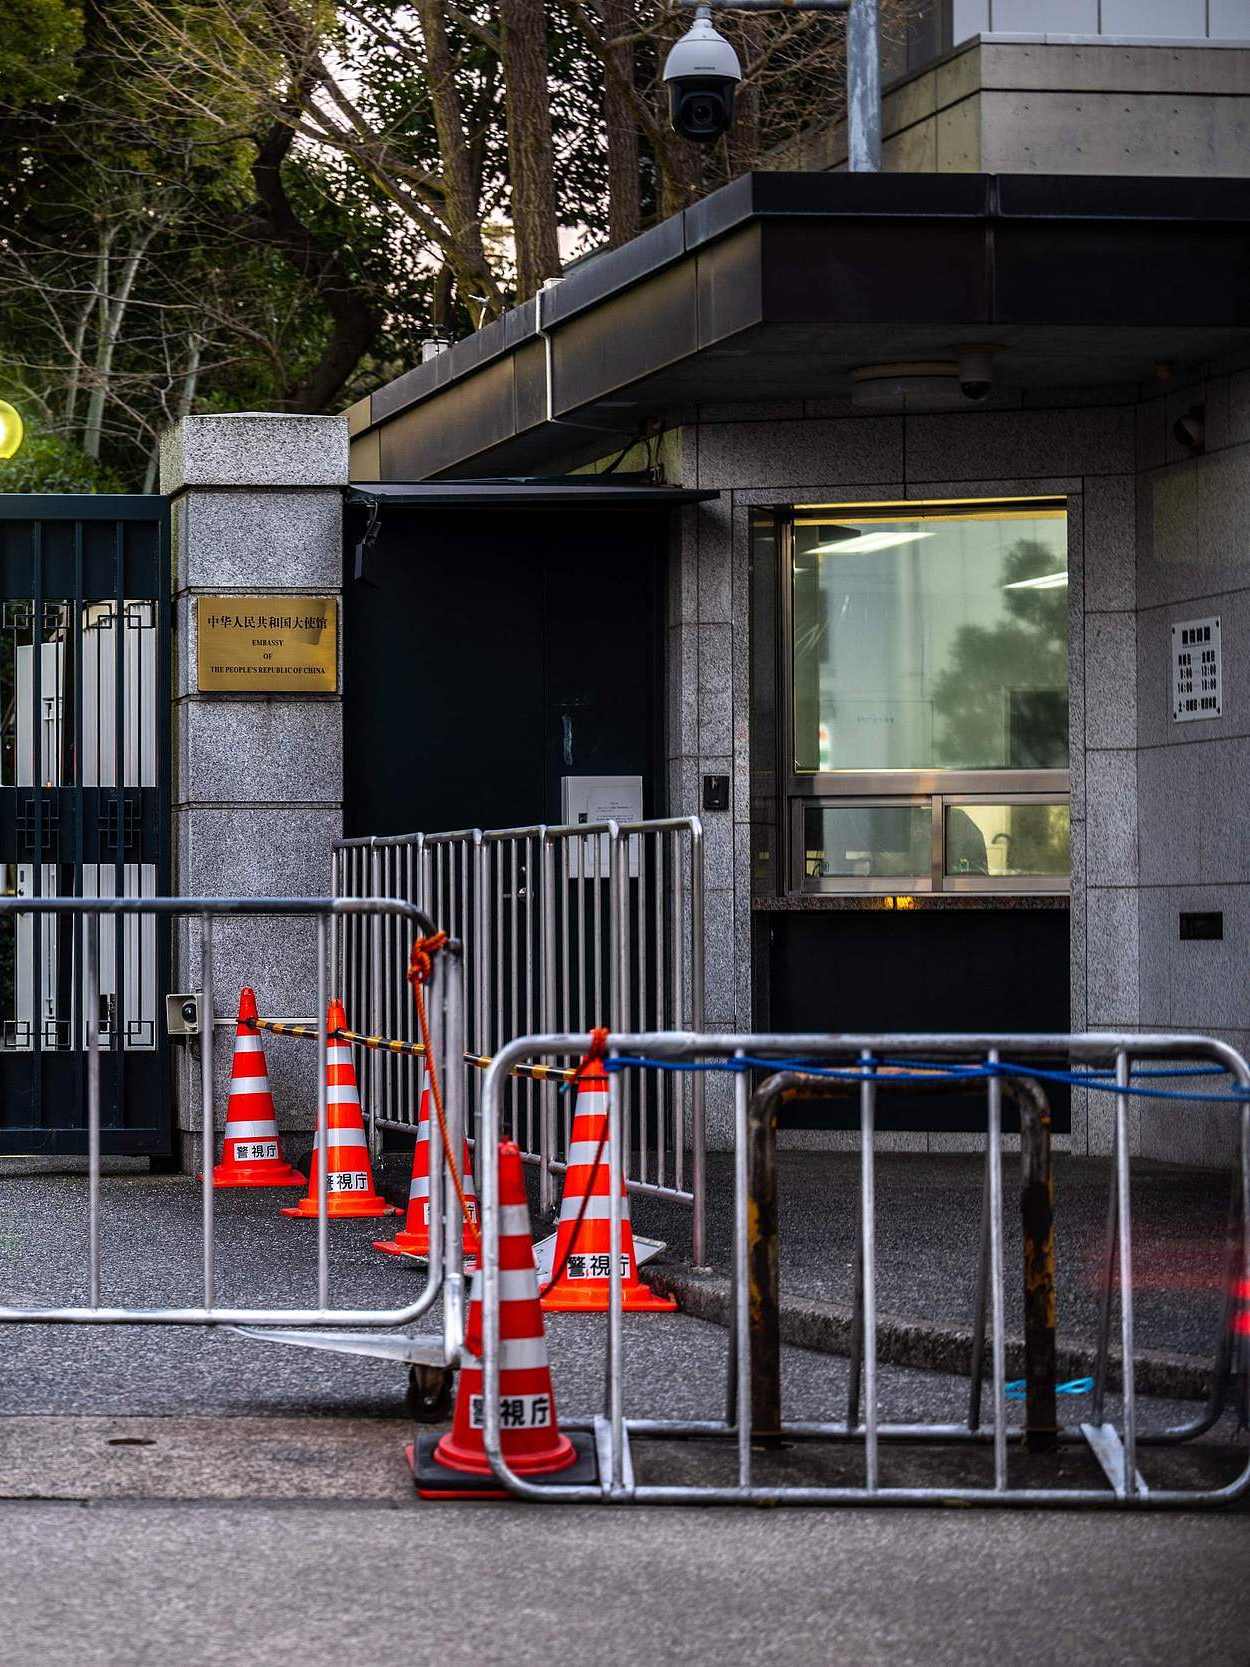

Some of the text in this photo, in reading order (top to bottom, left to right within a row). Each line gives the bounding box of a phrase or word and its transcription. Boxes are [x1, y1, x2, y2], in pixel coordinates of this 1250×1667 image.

[207, 615, 327, 629] 中华人民共和国大使馆
[252, 639, 284, 647] EMBASSY
[210, 666, 225, 674] THE
[225, 666, 258, 674] PEOPLE'S
[258, 666, 292, 674] REPUBLIC
[303, 667, 326, 675] CHINA
[236, 1144, 277, 1159] 警視庁
